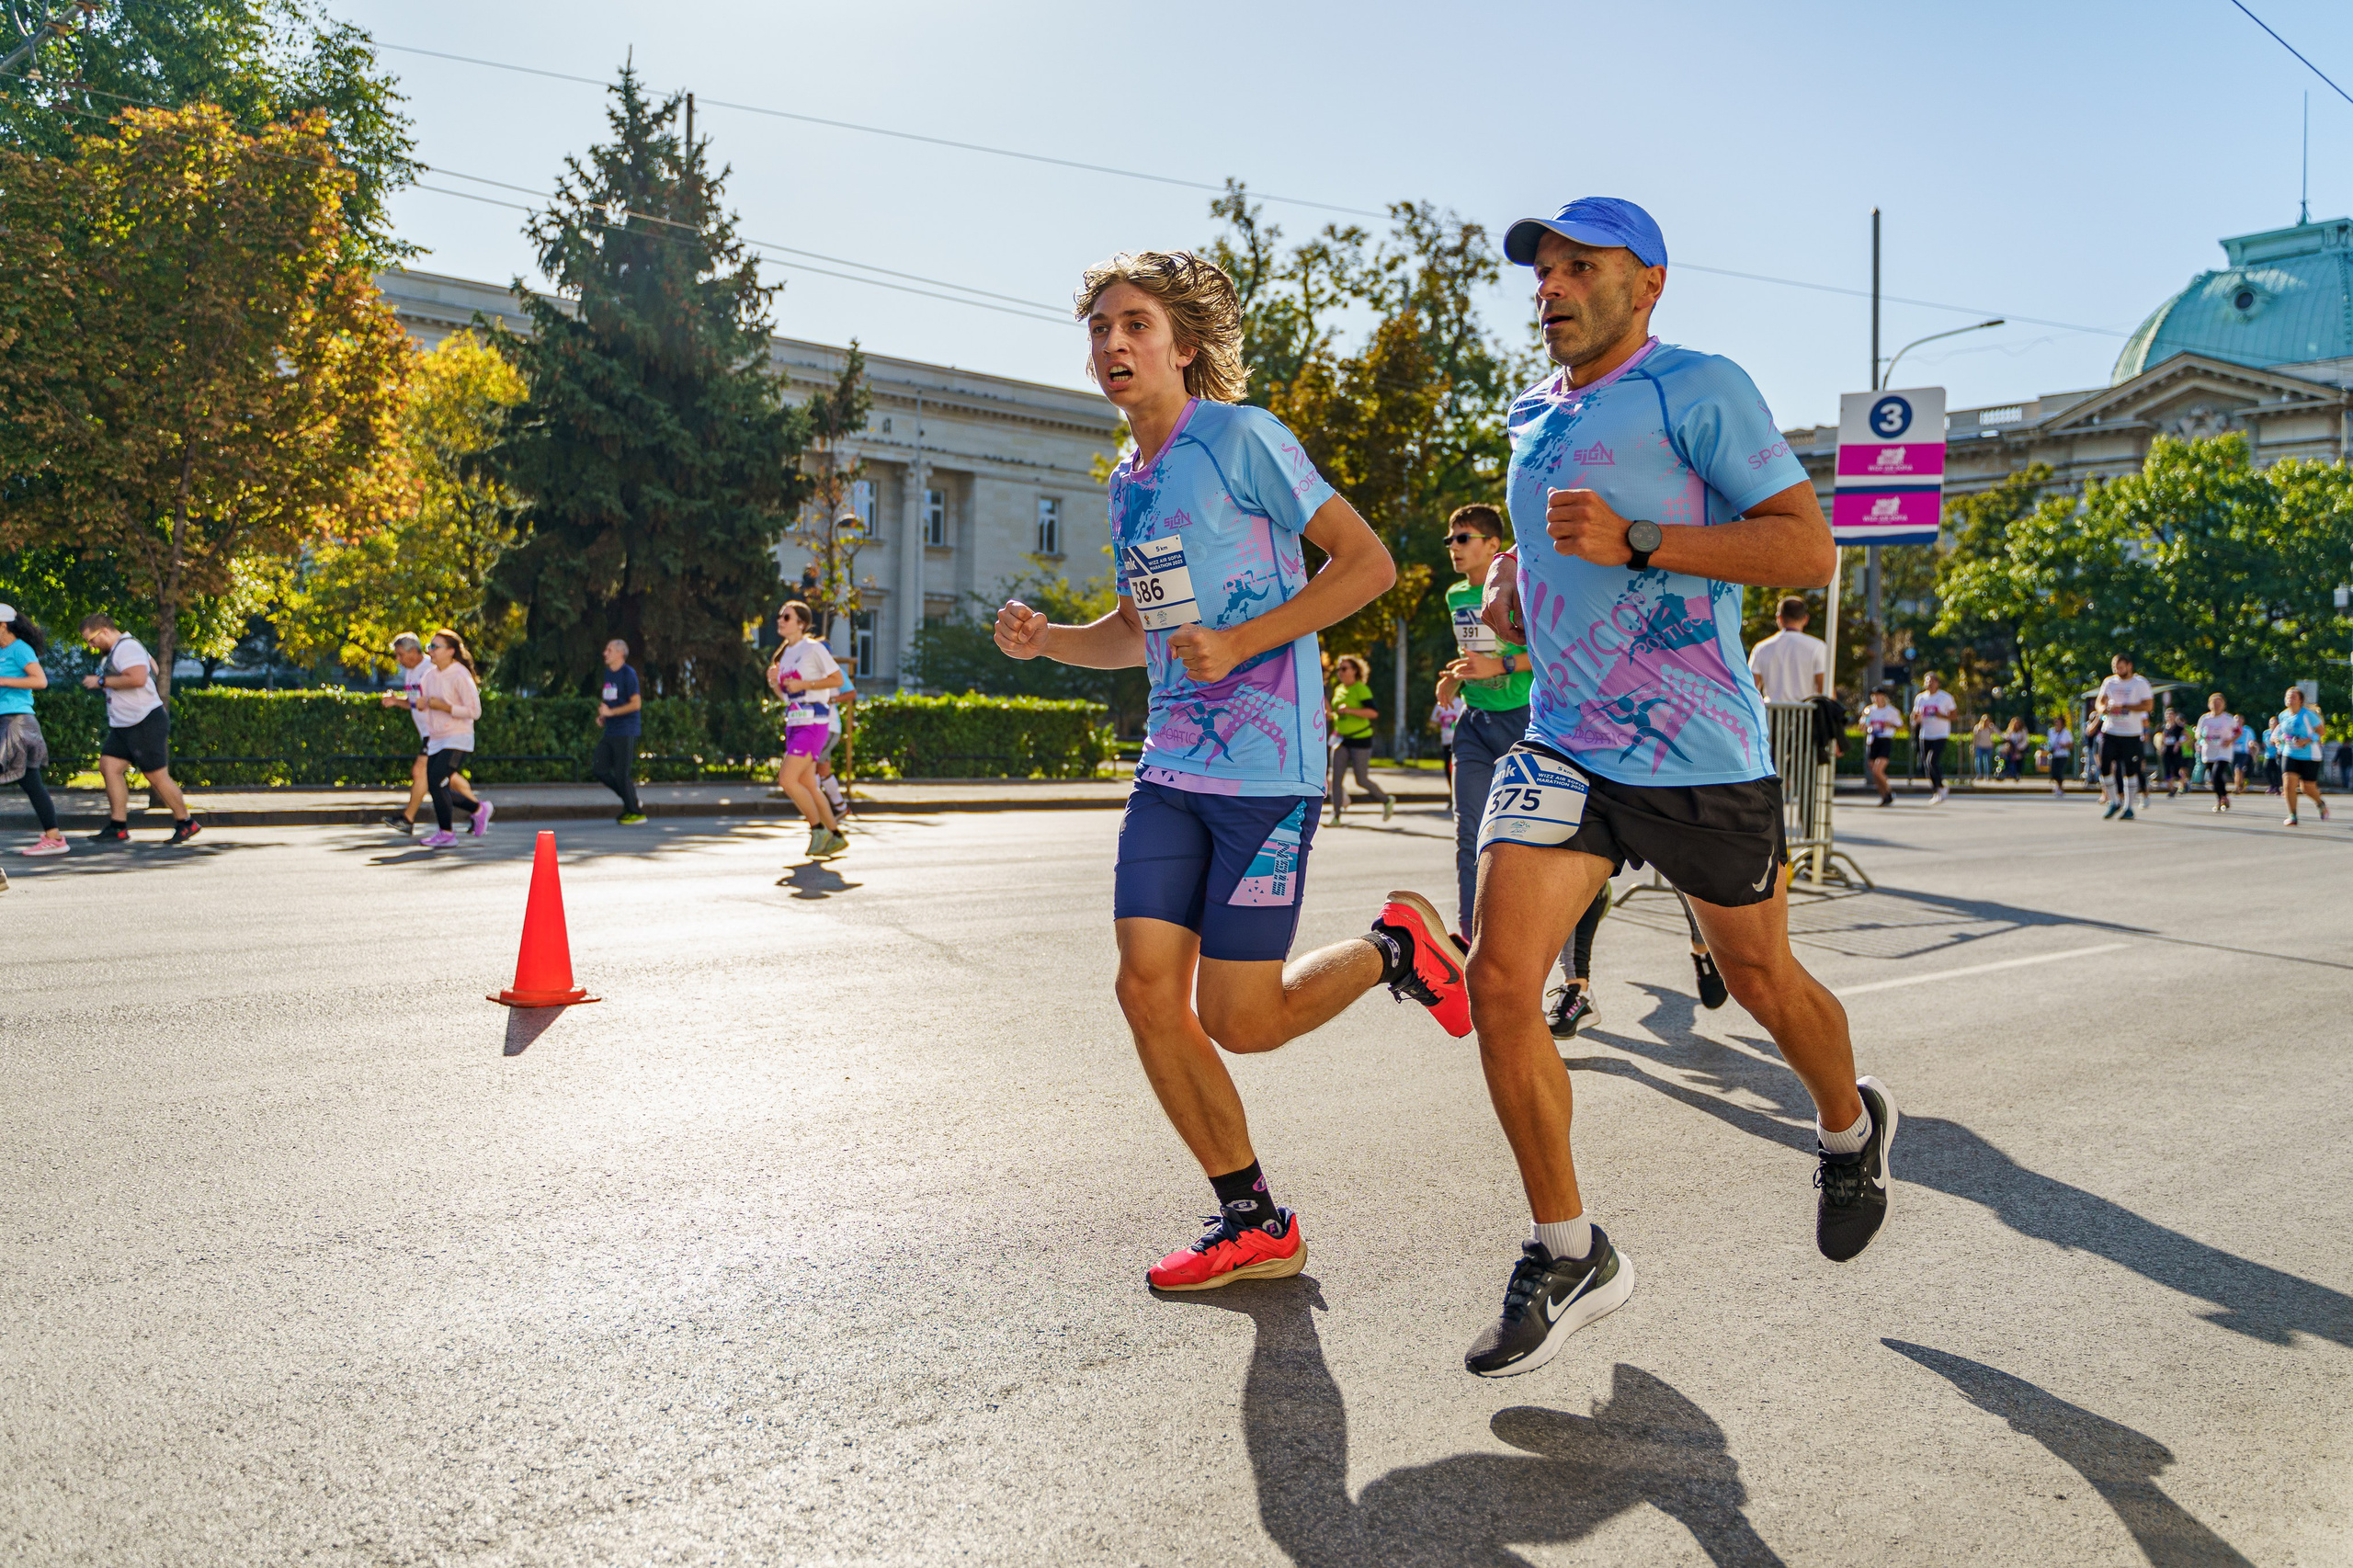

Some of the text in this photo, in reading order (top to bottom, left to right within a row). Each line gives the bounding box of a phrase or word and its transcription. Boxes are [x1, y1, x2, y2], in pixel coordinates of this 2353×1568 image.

[1879, 403, 1904, 432] 3
[1150, 562, 1172, 571] MARATHON
[1132, 578, 1165, 604] 386
[1462, 627, 1478, 638] 391
[1536, 778, 1570, 788] MARATHON
[1567, 778, 1586, 789] SOFIA
[1488, 789, 1542, 815] 375
